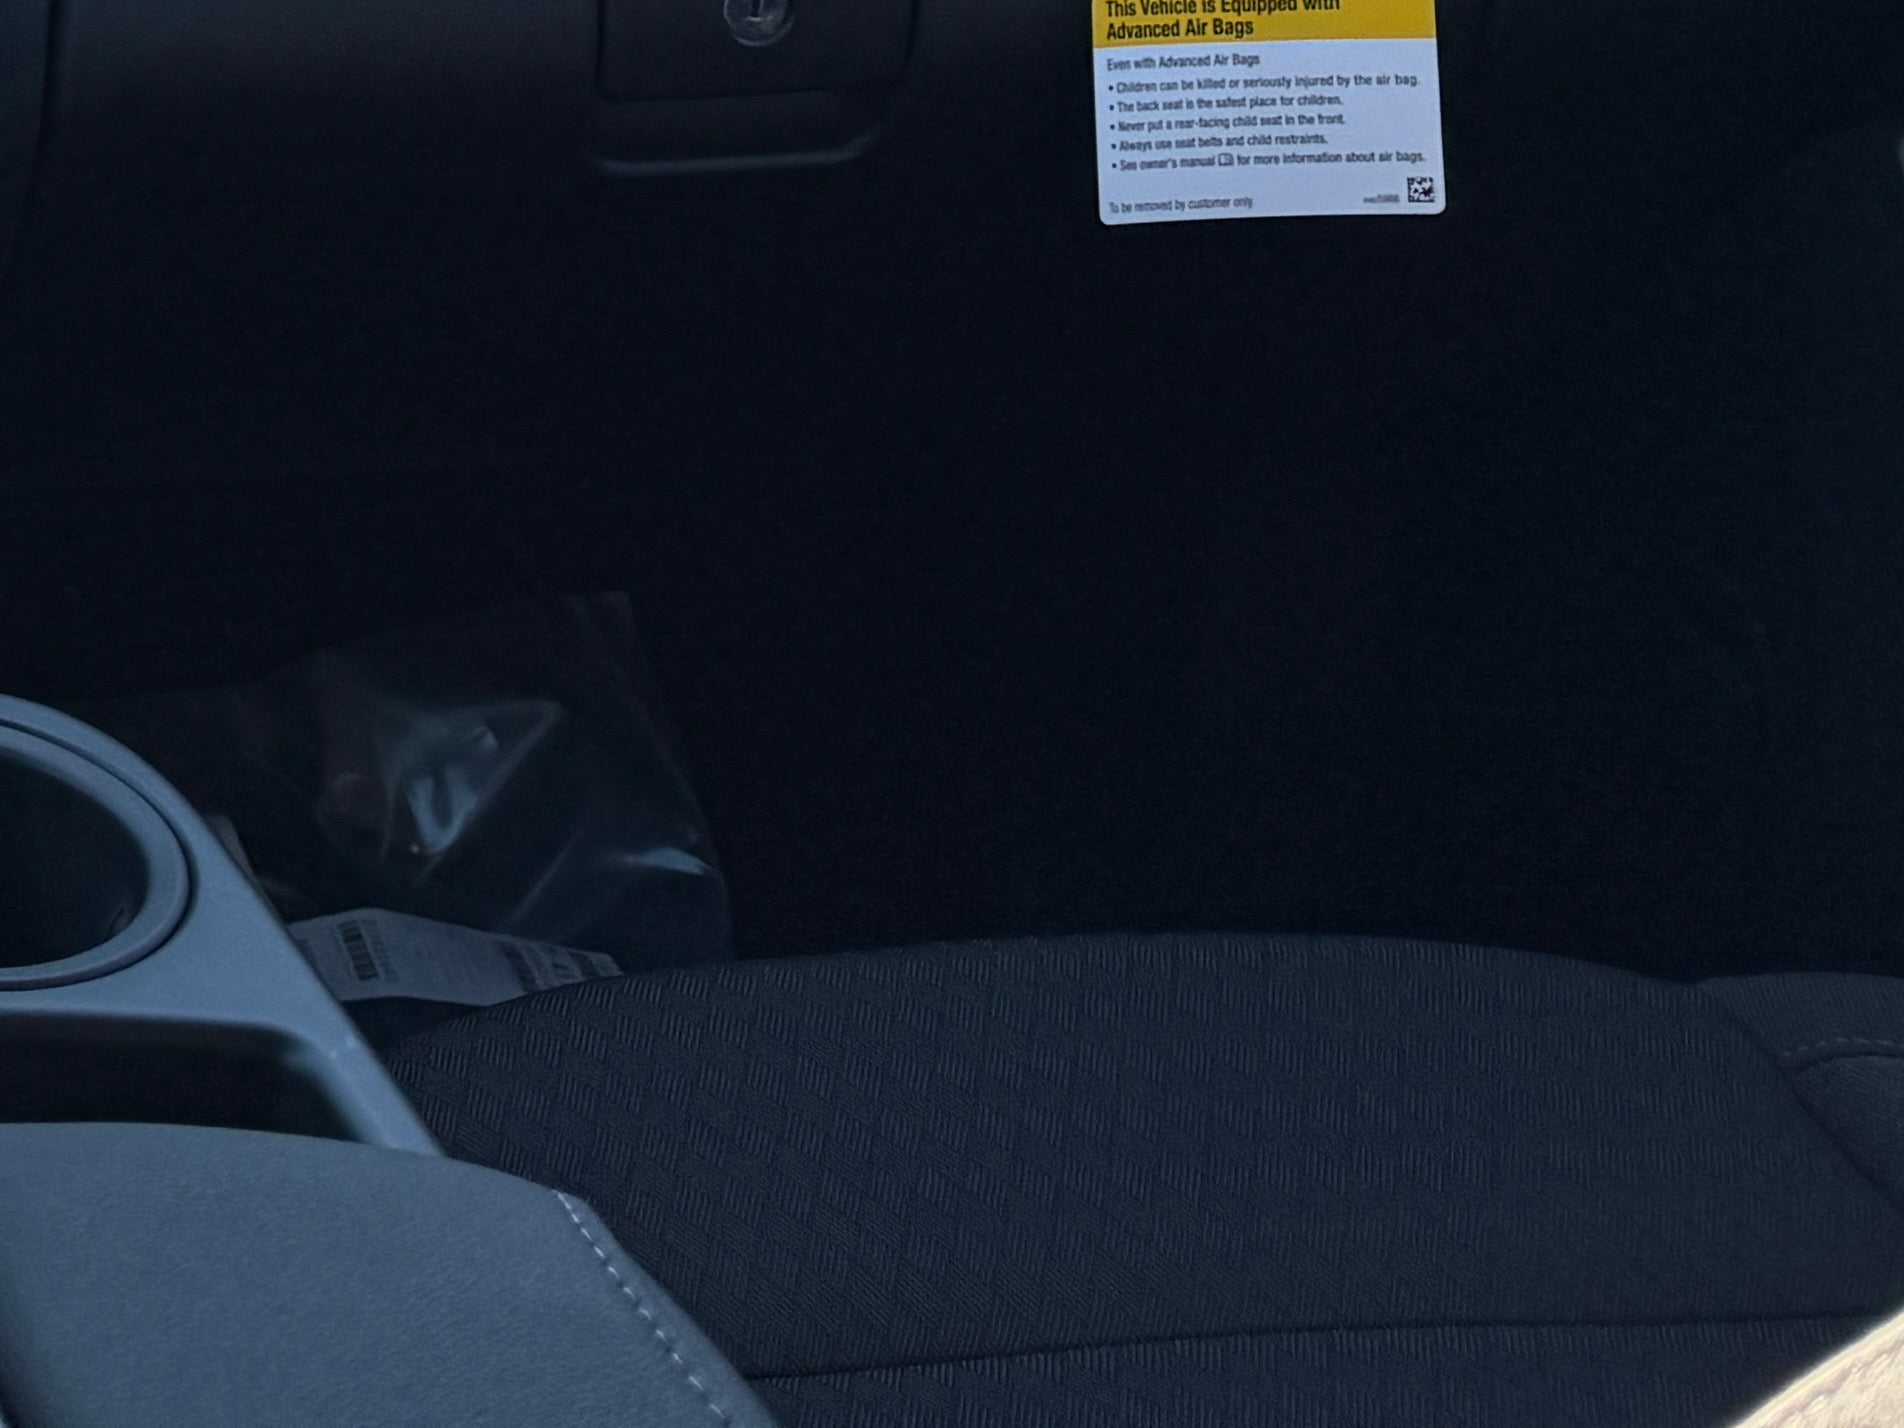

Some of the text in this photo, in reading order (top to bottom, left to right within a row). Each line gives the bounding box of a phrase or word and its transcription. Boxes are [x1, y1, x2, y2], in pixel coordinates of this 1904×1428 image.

[1107, 17, 1254, 41] Advanced Air Bags
[1106, 52, 1261, 72] Even with Advanced Air Bags
[1116, 81, 1157, 94] Children
[1159, 81, 1179, 92] can
[1180, 78, 1194, 91] be
[1196, 77, 1226, 91] killed
[1228, 78, 1240, 90] or
[1242, 75, 1292, 91] seriously
[1294, 73, 1335, 90] injured
[1336, 73, 1351, 89] by
[1353, 74, 1374, 87] the
[1376, 74, 1392, 86] air
[1117, 101, 1135, 113] The
[1136, 100, 1159, 112] back
[1162, 99, 1183, 111] seat
[1196, 97, 1213, 109] the
[1215, 96, 1246, 109] safest
[1249, 95, 1277, 110] place
[1280, 95, 1295, 107] for
[1147, 119, 1164, 134] put
[1166, 120, 1173, 130] a
[1174, 116, 1230, 130] rear-facing
[1232, 115, 1258, 128] child
[1260, 114, 1283, 127] seat
[1284, 114, 1296, 126] in
[1297, 113, 1315, 126] the
[1119, 140, 1153, 153] Always
[1155, 139, 1172, 150] use
[1175, 137, 1196, 150] seat
[1198, 135, 1223, 149] belts
[1225, 135, 1245, 147] and
[1247, 134, 1272, 146] child
[1179, 155, 1216, 168] manual
[1237, 154, 1252, 166] for
[1253, 154, 1281, 166] more
[1282, 152, 1343, 165] information
[1345, 151, 1376, 164] about
[1378, 150, 1394, 163] air
[1121, 200, 1134, 214] be
[1134, 199, 1174, 213] removed
[1175, 198, 1187, 213] by
[1188, 196, 1232, 210] customer
